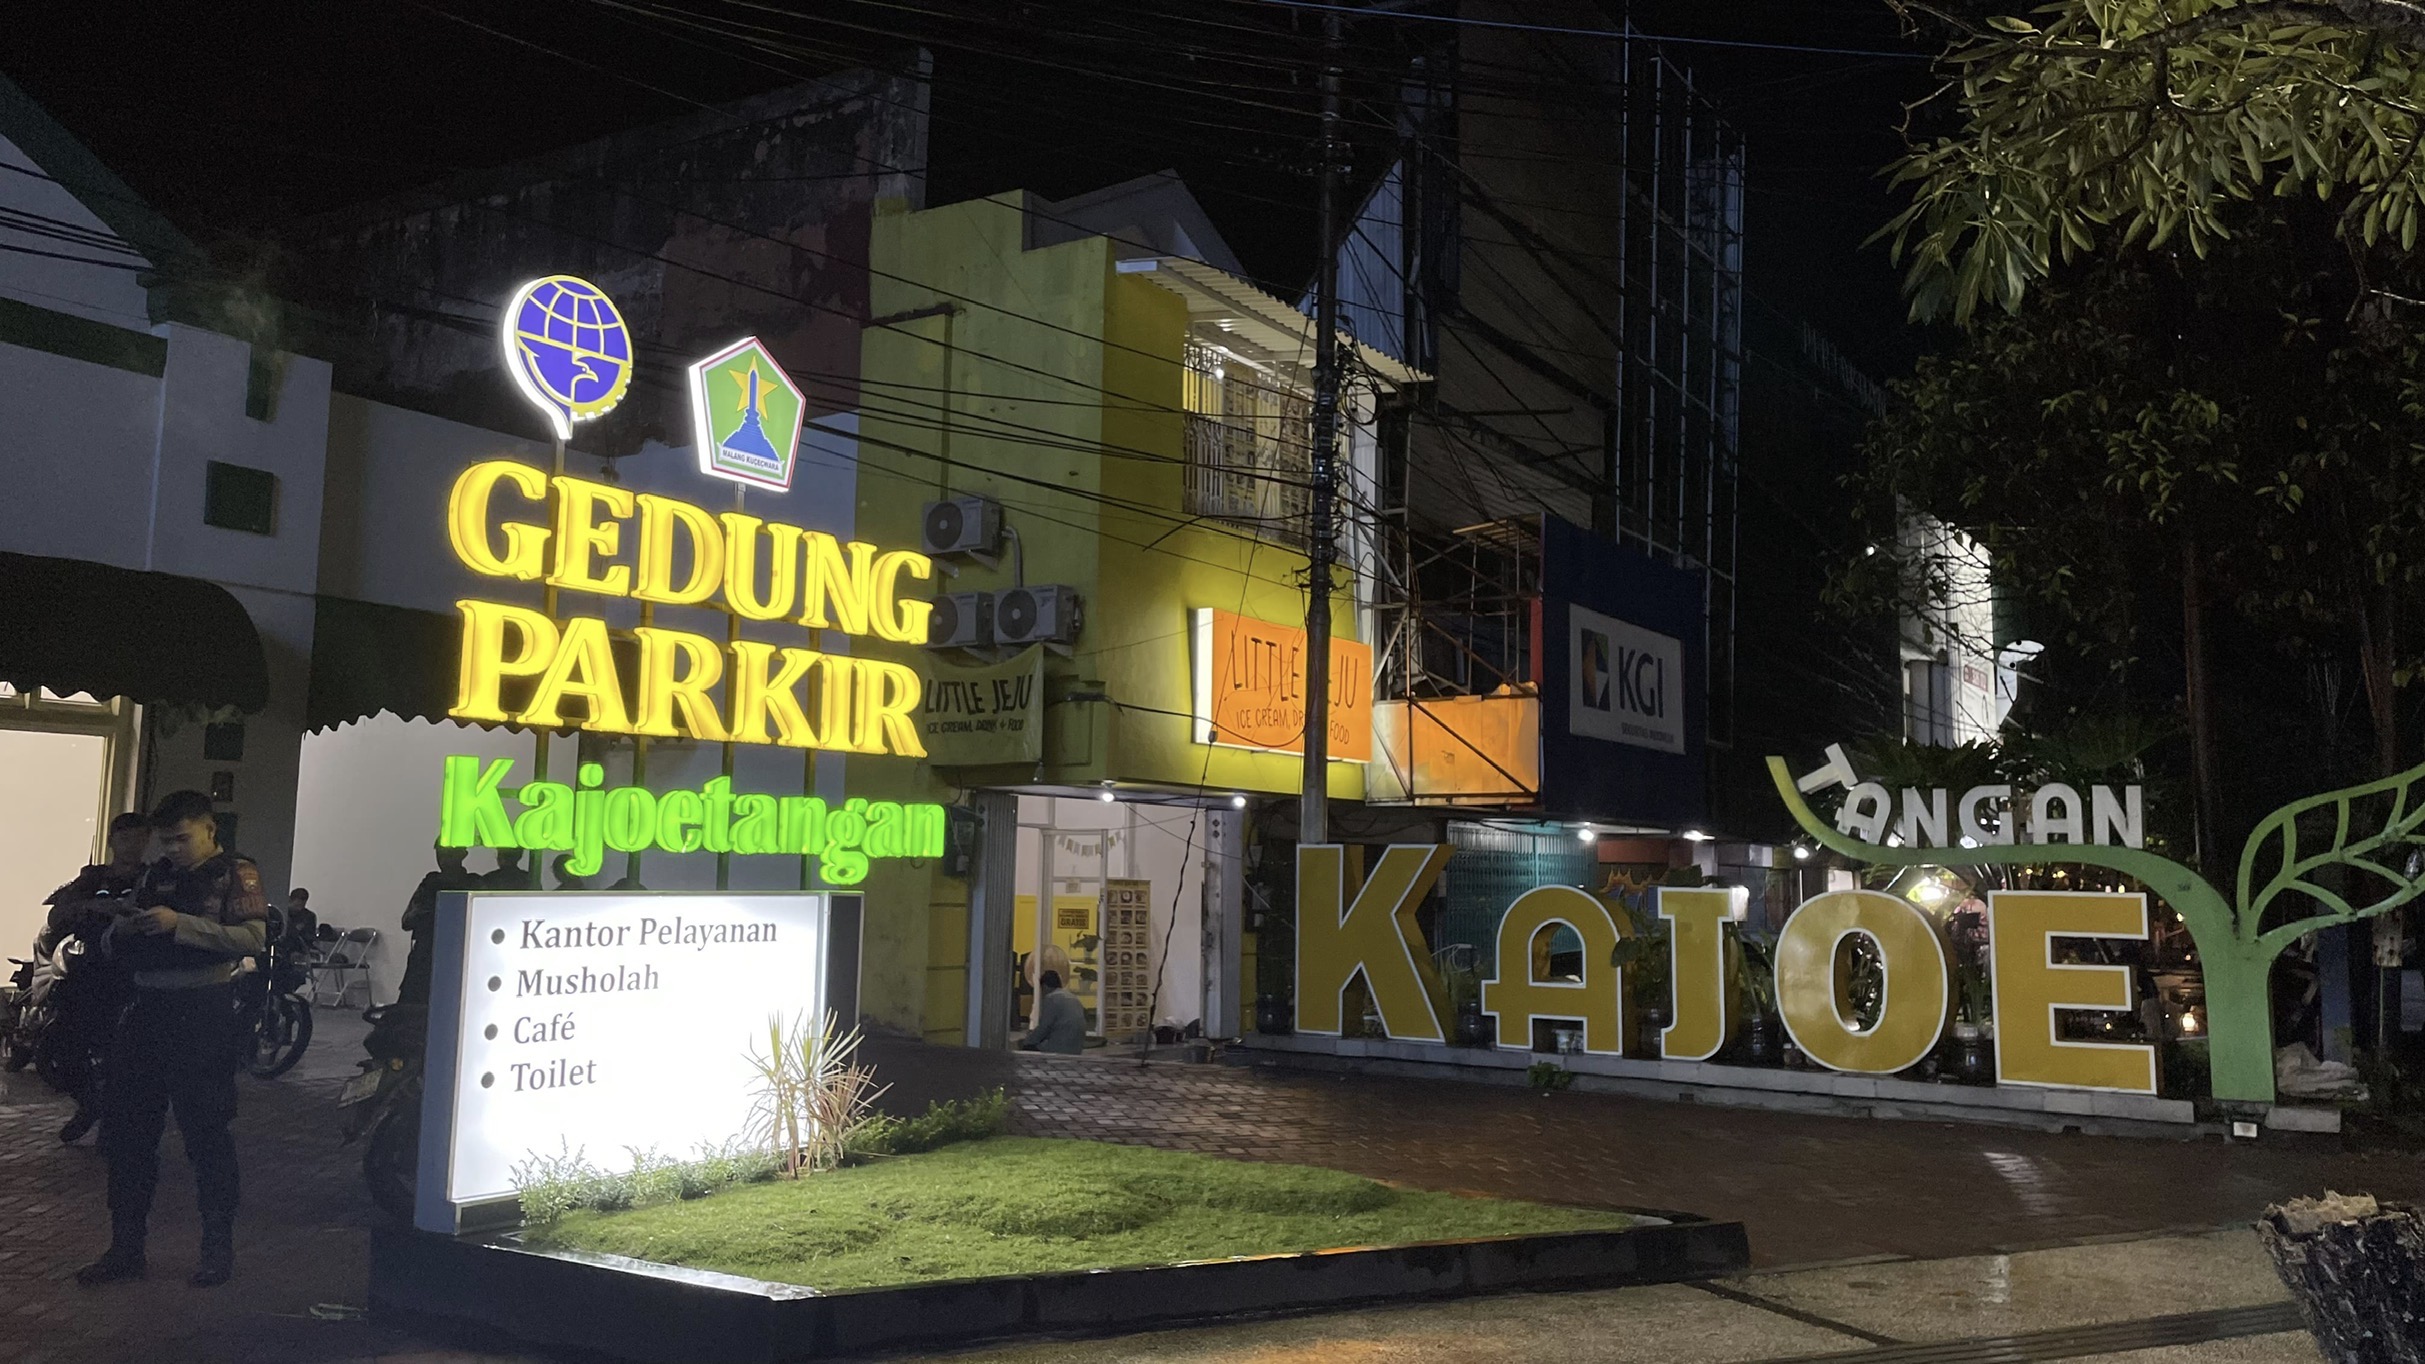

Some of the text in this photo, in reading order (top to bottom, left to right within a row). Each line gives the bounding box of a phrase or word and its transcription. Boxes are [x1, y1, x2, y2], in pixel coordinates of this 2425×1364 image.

[722, 449, 745, 463] MALANG
[448, 460, 933, 645] GEDUNG
[449, 599, 928, 758] PARKIR
[1231, 630, 1300, 702] LITTLE
[1618, 646, 1664, 719] KGI
[925, 674, 1033, 715] LITTLE JEJU
[1236, 708, 1251, 730] ICE
[1330, 720, 1350, 745] FOOD
[440, 754, 945, 885] Kajoetangan
[1798, 742, 2144, 849] TANGAN
[519, 916, 778, 951] Kantor Pelayanan
[516, 964, 660, 998] Musholah
[1294, 843, 2158, 1095] KAJOE
[513, 1011, 576, 1044] Café
[510, 1058, 597, 1092] Toilet
